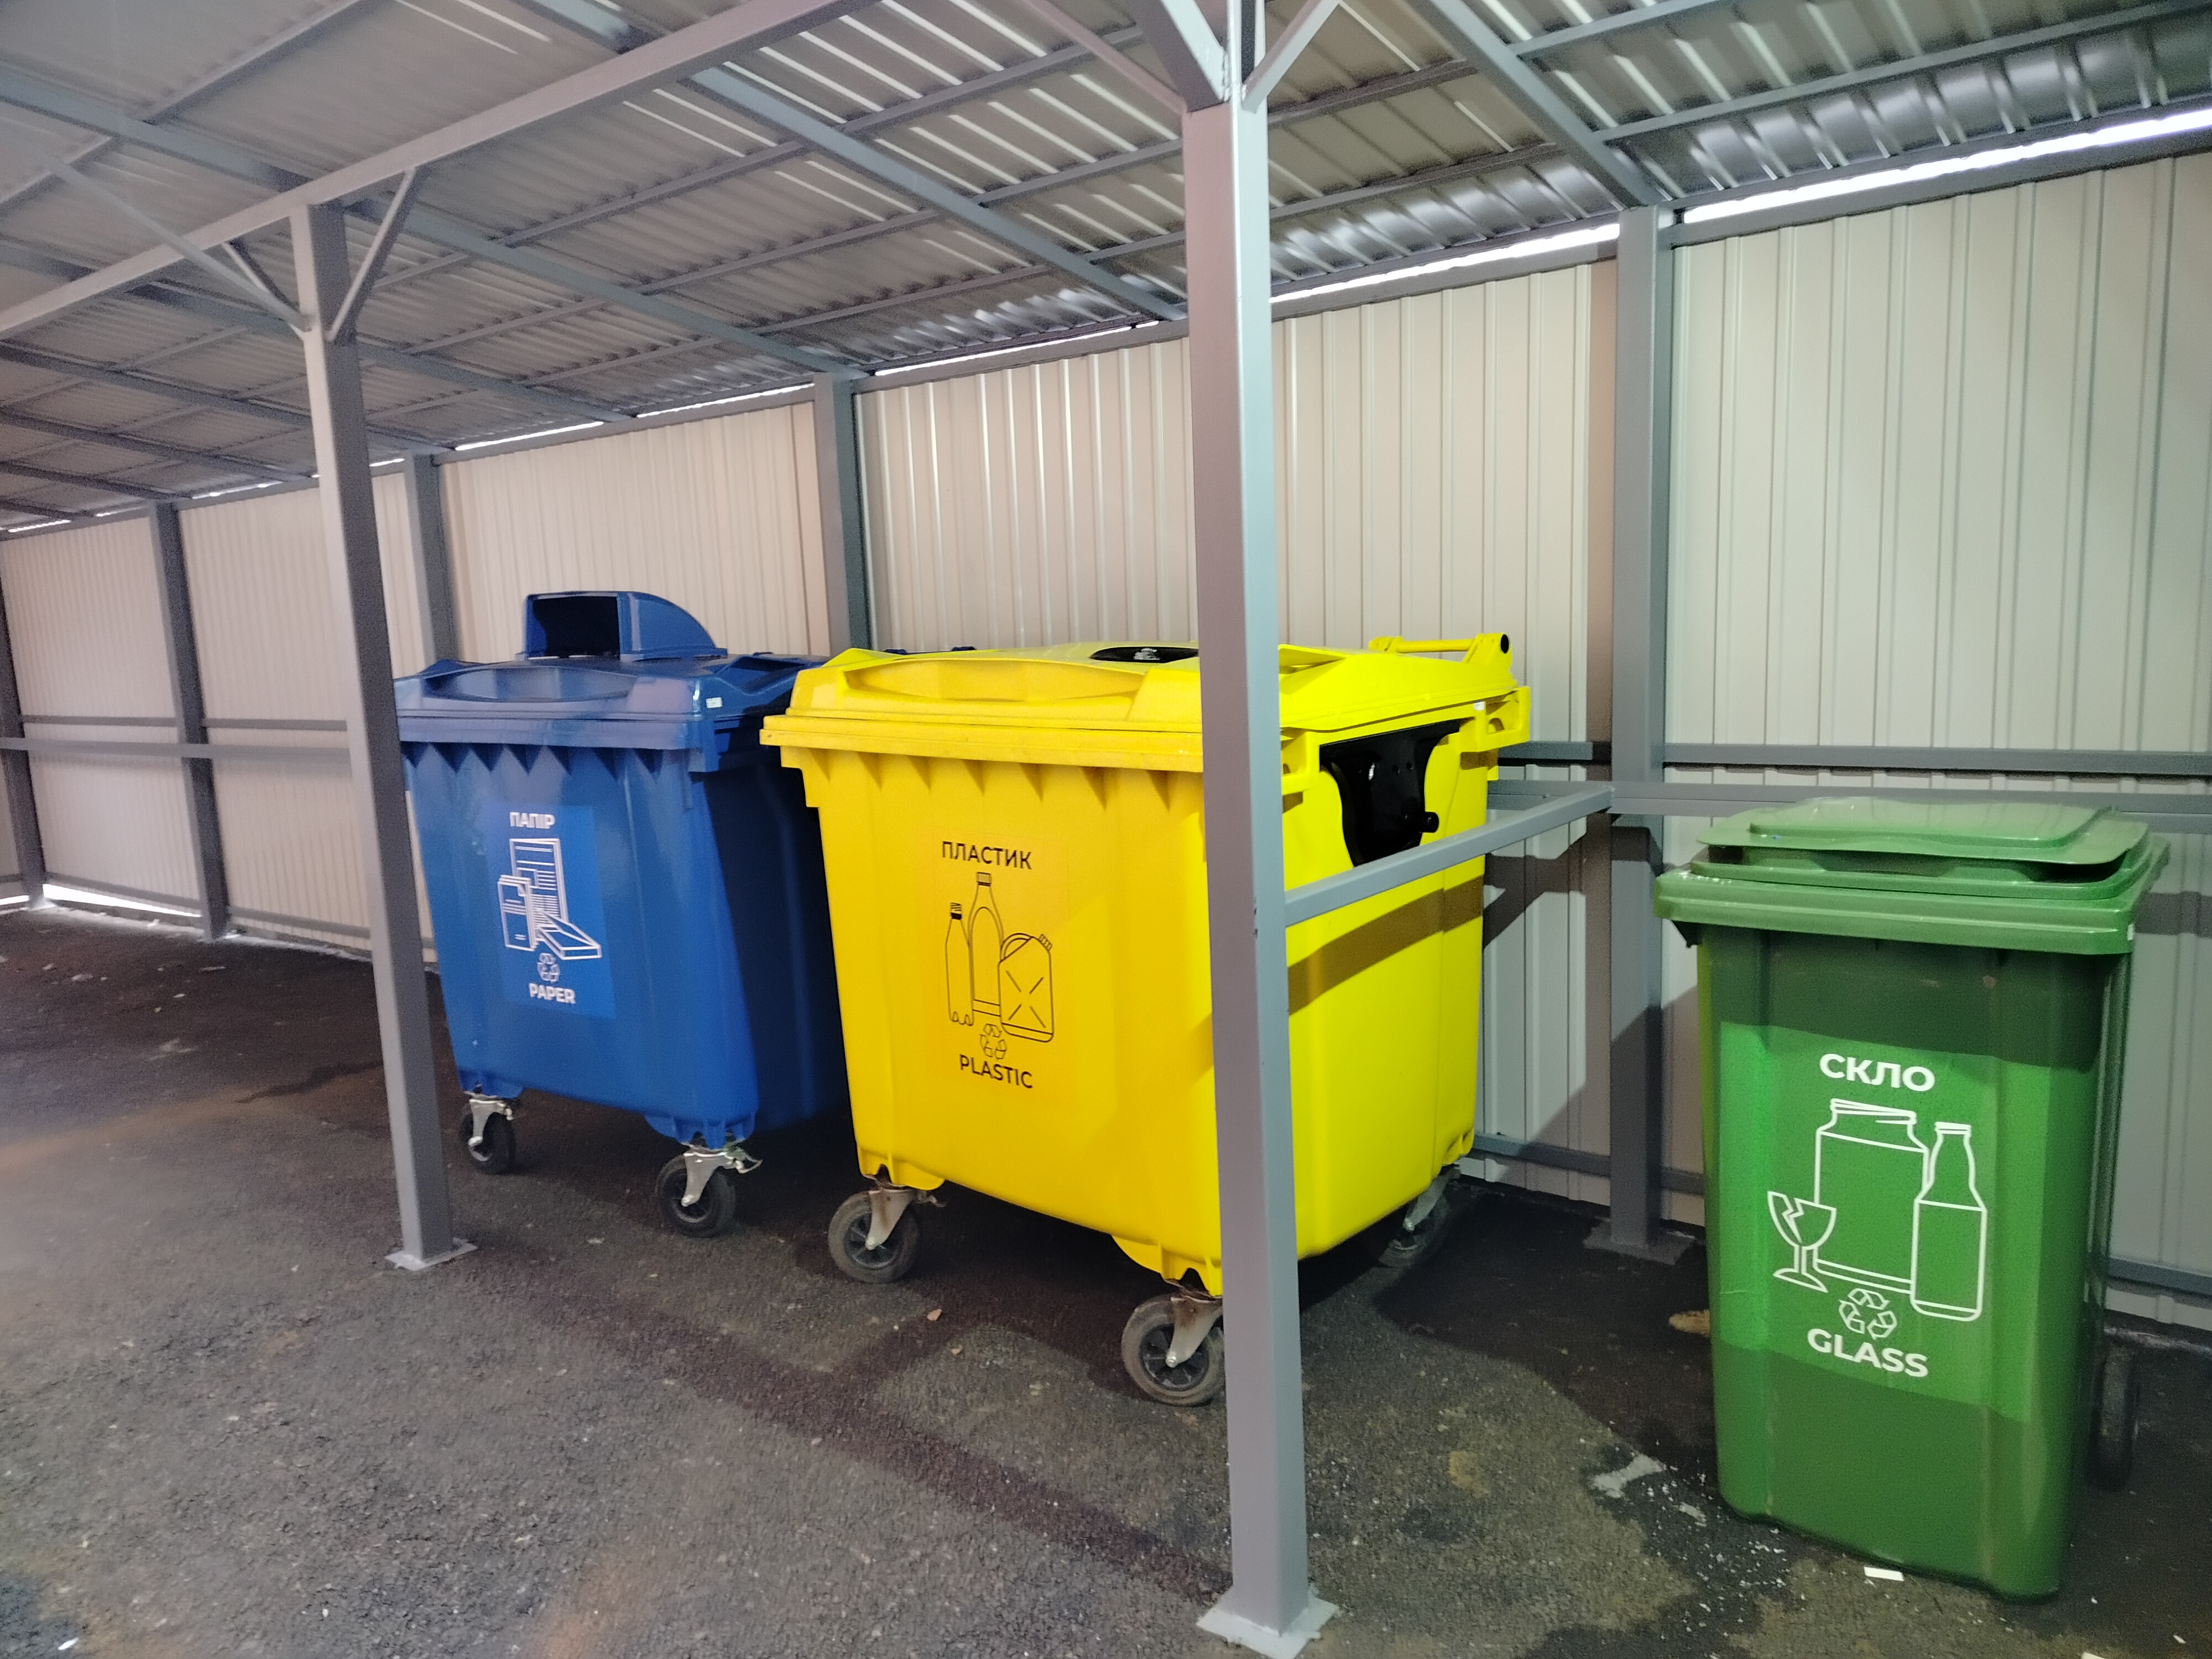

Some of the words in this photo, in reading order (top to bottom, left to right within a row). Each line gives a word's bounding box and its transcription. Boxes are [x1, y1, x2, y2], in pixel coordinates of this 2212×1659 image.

[509, 812, 555, 829] ПАПІР
[942, 841, 1032, 870] ПЛАСТИК
[529, 983, 576, 1004] PAPER
[959, 1054, 1033, 1089] PLASTIC
[1819, 1053, 1936, 1092] СКЛО
[1807, 1328, 1929, 1378] GLASS
